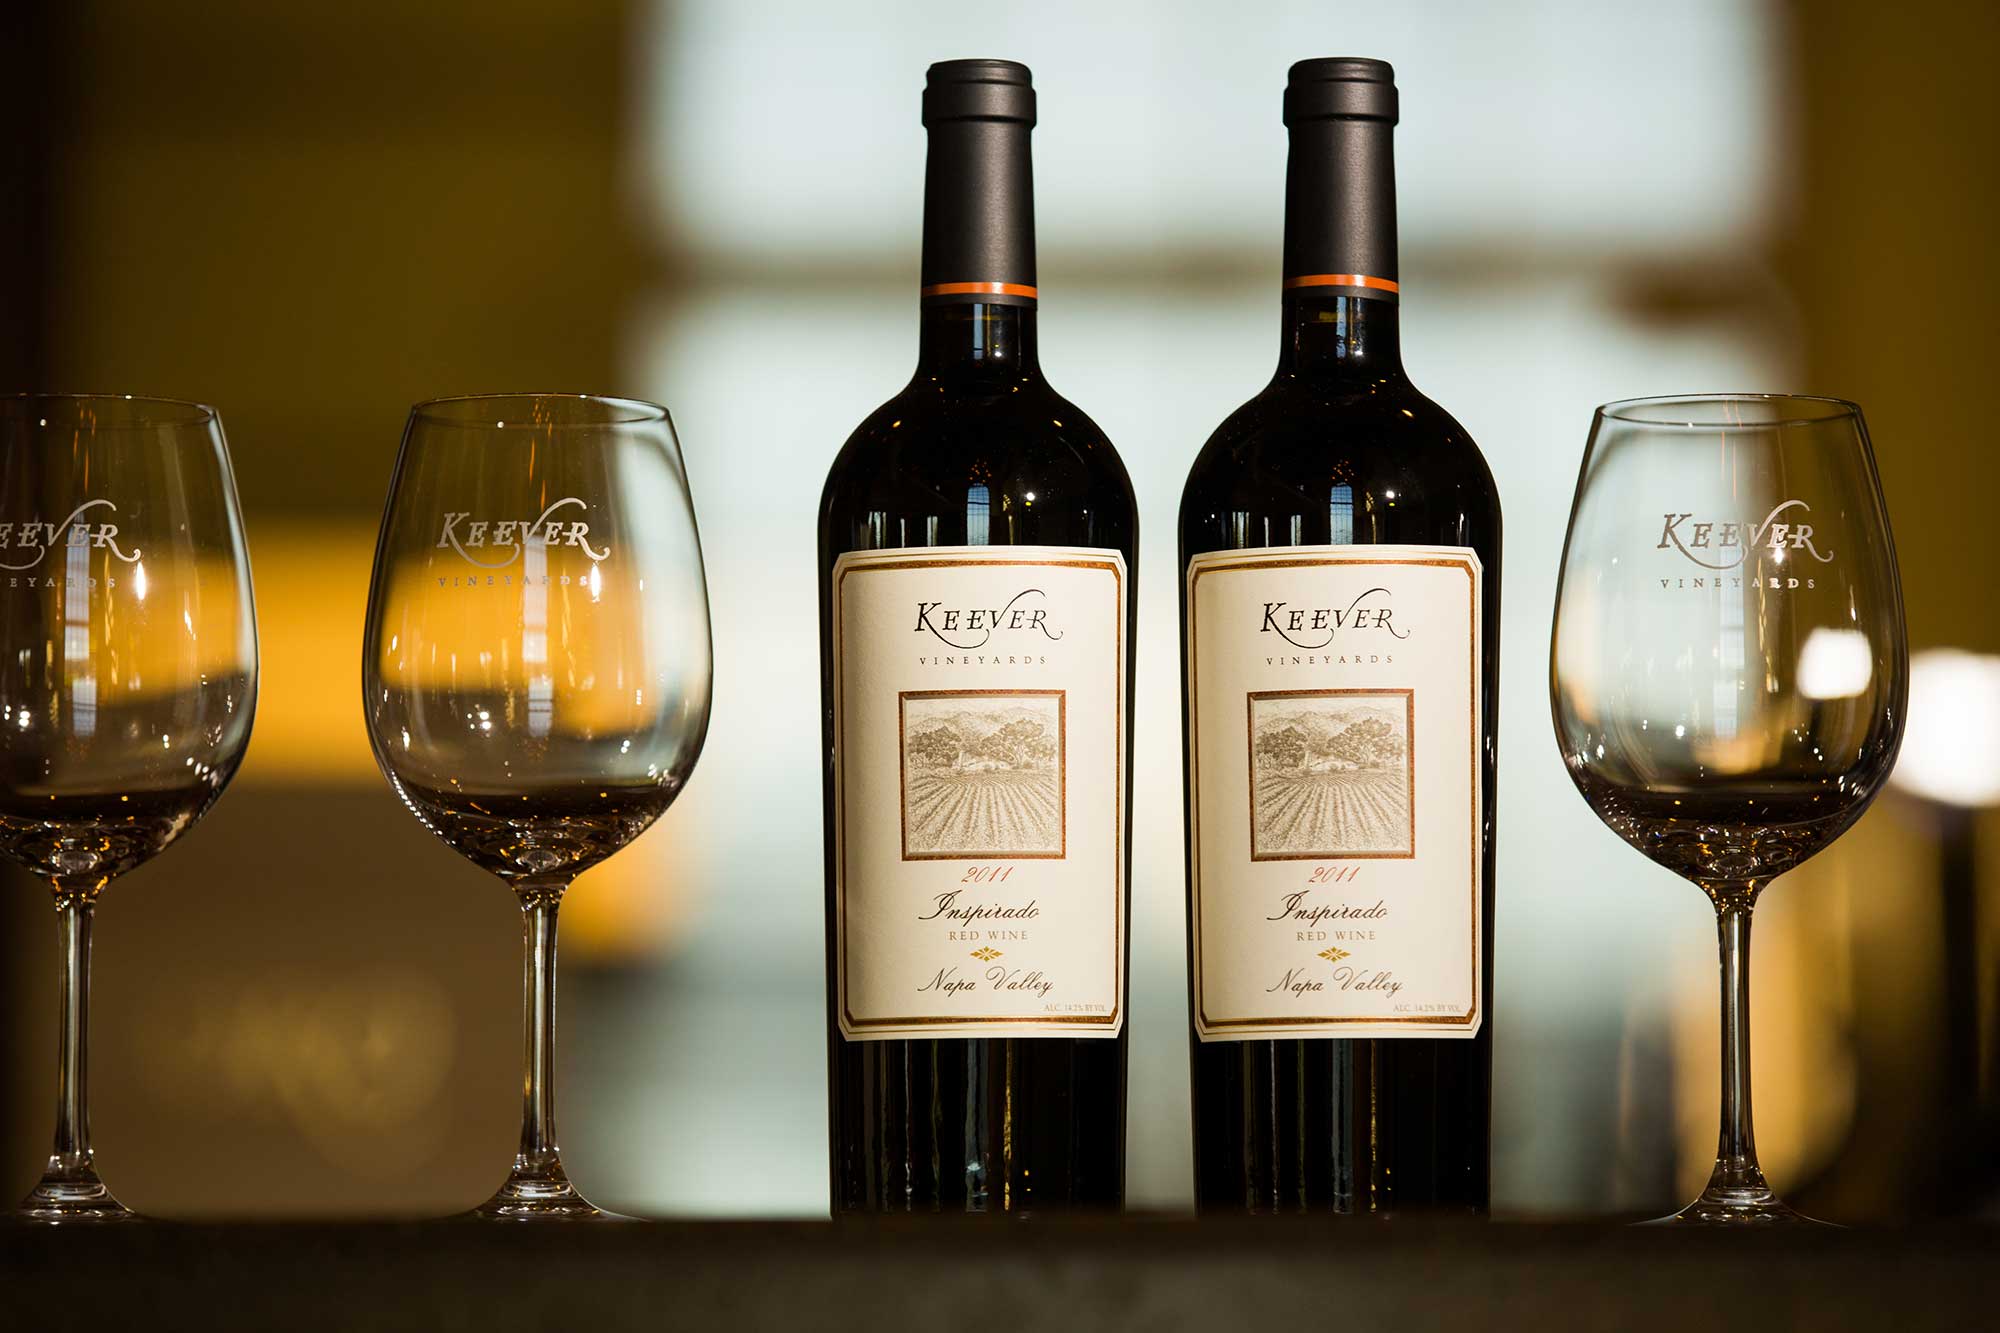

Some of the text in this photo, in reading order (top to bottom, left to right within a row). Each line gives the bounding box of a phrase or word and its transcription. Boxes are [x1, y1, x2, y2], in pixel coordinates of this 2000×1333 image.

[0, 499, 141, 570] EEVER
[436, 497, 611, 568] KEEVER
[1657, 499, 1834, 570] KEEVER
[10, 577, 115, 588] EYARDS
[1661, 577, 1815, 589] VINEYARDS
[914, 588, 1064, 649] KEEVER
[1260, 588, 1411, 649] KEEVER
[919, 656, 1047, 665] VINEYARDS
[1266, 655, 1393, 665] VINEYARDS
[961, 866, 1014, 883] 2011
[1308, 866, 1361, 883] 2011
[918, 889, 1040, 927] Inspirado
[1266, 889, 1388, 928] Inspirado
[949, 930, 1028, 941] RED WINE
[1296, 930, 1376, 942] RED WINE
[917, 965, 1053, 998] Napa Valley
[1265, 966, 1404, 999] Napa Valley
